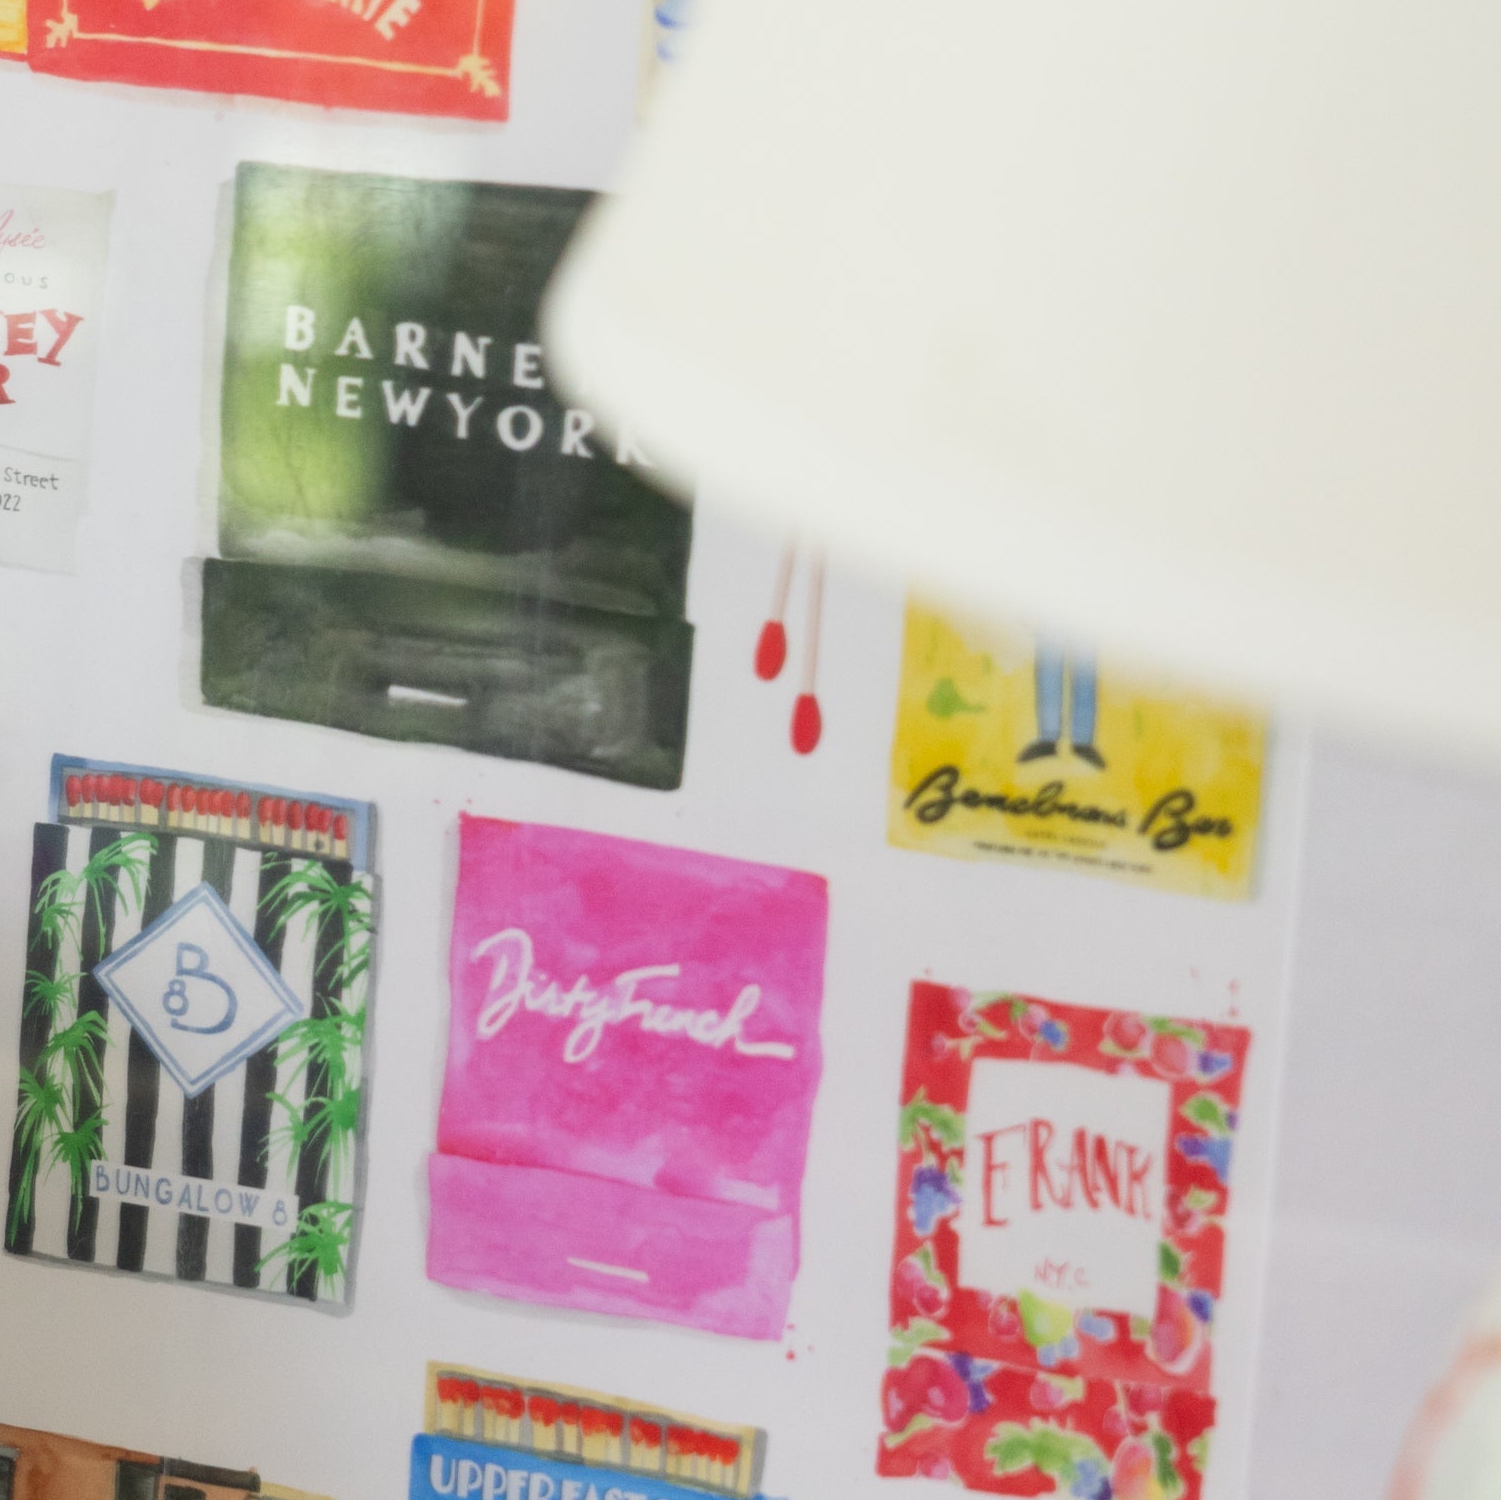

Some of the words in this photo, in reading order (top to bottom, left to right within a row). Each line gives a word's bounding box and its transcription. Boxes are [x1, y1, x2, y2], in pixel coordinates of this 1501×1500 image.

[275, 362, 432, 430] NEW
[3, 466, 60, 492] Street
[468, 927, 608, 1064] Dirty
[95, 1163, 261, 1219] BUNGALOW
[271, 1198, 288, 1227] 8
